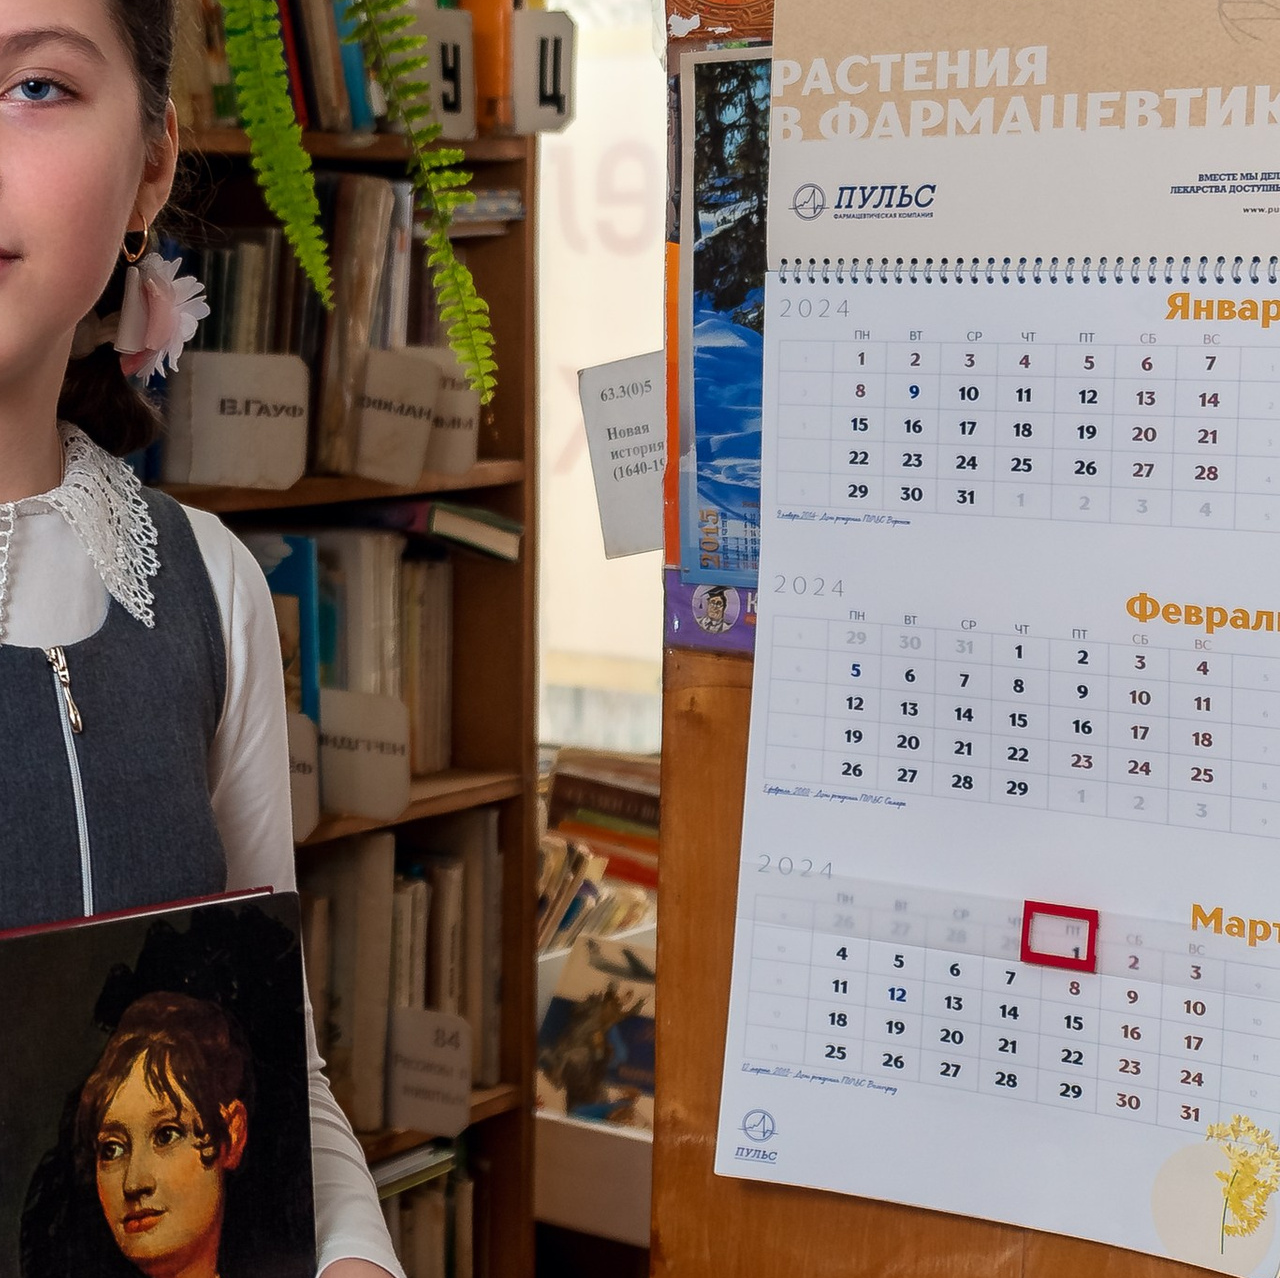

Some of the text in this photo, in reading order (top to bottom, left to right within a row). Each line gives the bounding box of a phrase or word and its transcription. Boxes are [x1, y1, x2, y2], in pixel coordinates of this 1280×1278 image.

[440, 42, 462, 113] У
[539, 36, 566, 114] Ц
[772, 45, 1048, 97] РАСТЕНИЯ
[773, 105, 803, 142] В
[1170, 185, 1227, 194] ЛЕКАРСТВА
[1198, 173, 1238, 182] ВМЕСТЕ
[1240, 172, 1259, 182] МЫ
[834, 183, 937, 210] ПУЛЬС
[833, 212, 897, 220] ФАРМАЦЕВТИЧЕСКАЯ
[779, 298, 852, 320] 2024
[1165, 291, 1280, 329] Январ
[854, 329, 1221, 345] ПН ВТ СР ЧТ ПТ СБ ВС
[857, 351, 1217, 372] 1 2 3 4 5 6 7
[600, 379, 653, 403] 63.3(0)5
[855, 383, 1221, 408] 8 10 11 12 13 14
[606, 423, 650, 441] Новая
[850, 417, 1218, 445] 15 16 17 18 19 20 21
[610, 439, 665, 460] история
[848, 450, 1219, 481] 22 23 24 25 26 27 28
[848, 484, 975, 505] 29 30 31
[699, 508, 720, 570] 2015
[773, 574, 845, 598] 2024
[1125, 592, 1280, 635] Феврал
[849, 610, 1211, 651] ПН ВТ СР ЧТ ПТ СБ ВС
[846, 696, 1213, 748] 12 13 14 15 16 17 18
[844, 729, 1214, 783] 19 20 21 22 23 24 25
[841, 761, 1029, 796] 26 27 28 29
[758, 854, 834, 879] 2024
[832, 979, 1204, 1051] 11 12 13 14 15 16 17
[828, 1012, 1205, 1087] 18 19 20 21 22 23 24
[824, 1044, 1200, 1123] 25 26 27 28 29 30 31
[734, 1146, 778, 1161] ПУЛЬС
